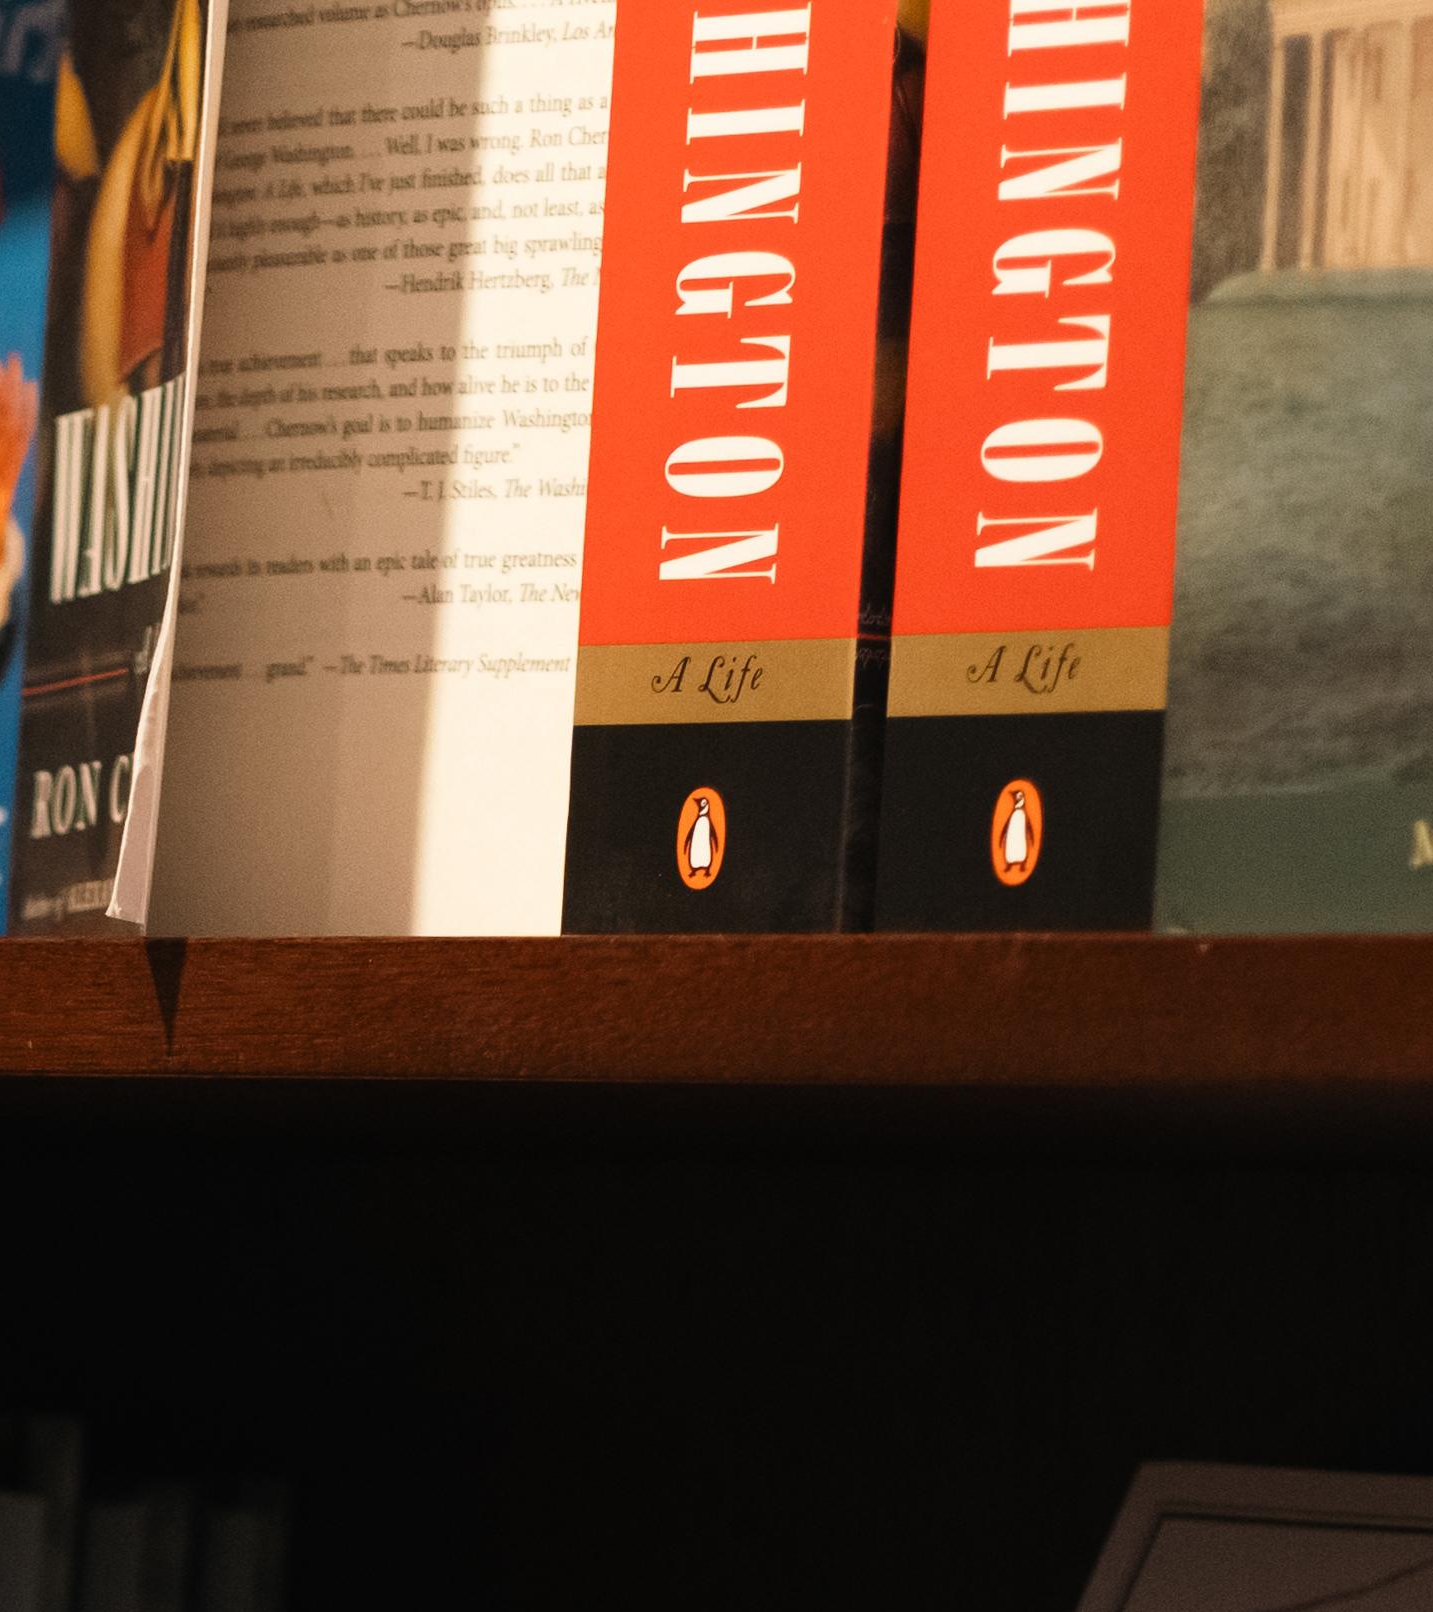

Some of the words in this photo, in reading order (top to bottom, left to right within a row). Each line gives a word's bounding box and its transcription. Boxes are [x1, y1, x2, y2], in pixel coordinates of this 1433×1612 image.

[528, 128, 563, 149] Ron
[495, 339, 564, 364] triumph
[463, 552, 496, 570] true
[501, 551, 577, 575] greatness
[478, 653, 571, 678] Supplement
[966, 643, 1007, 686] A
[1012, 642, 1083, 695] Life
[650, 654, 690, 696] A
[694, 654, 767, 703] Life
[31, 760, 102, 840] RON
